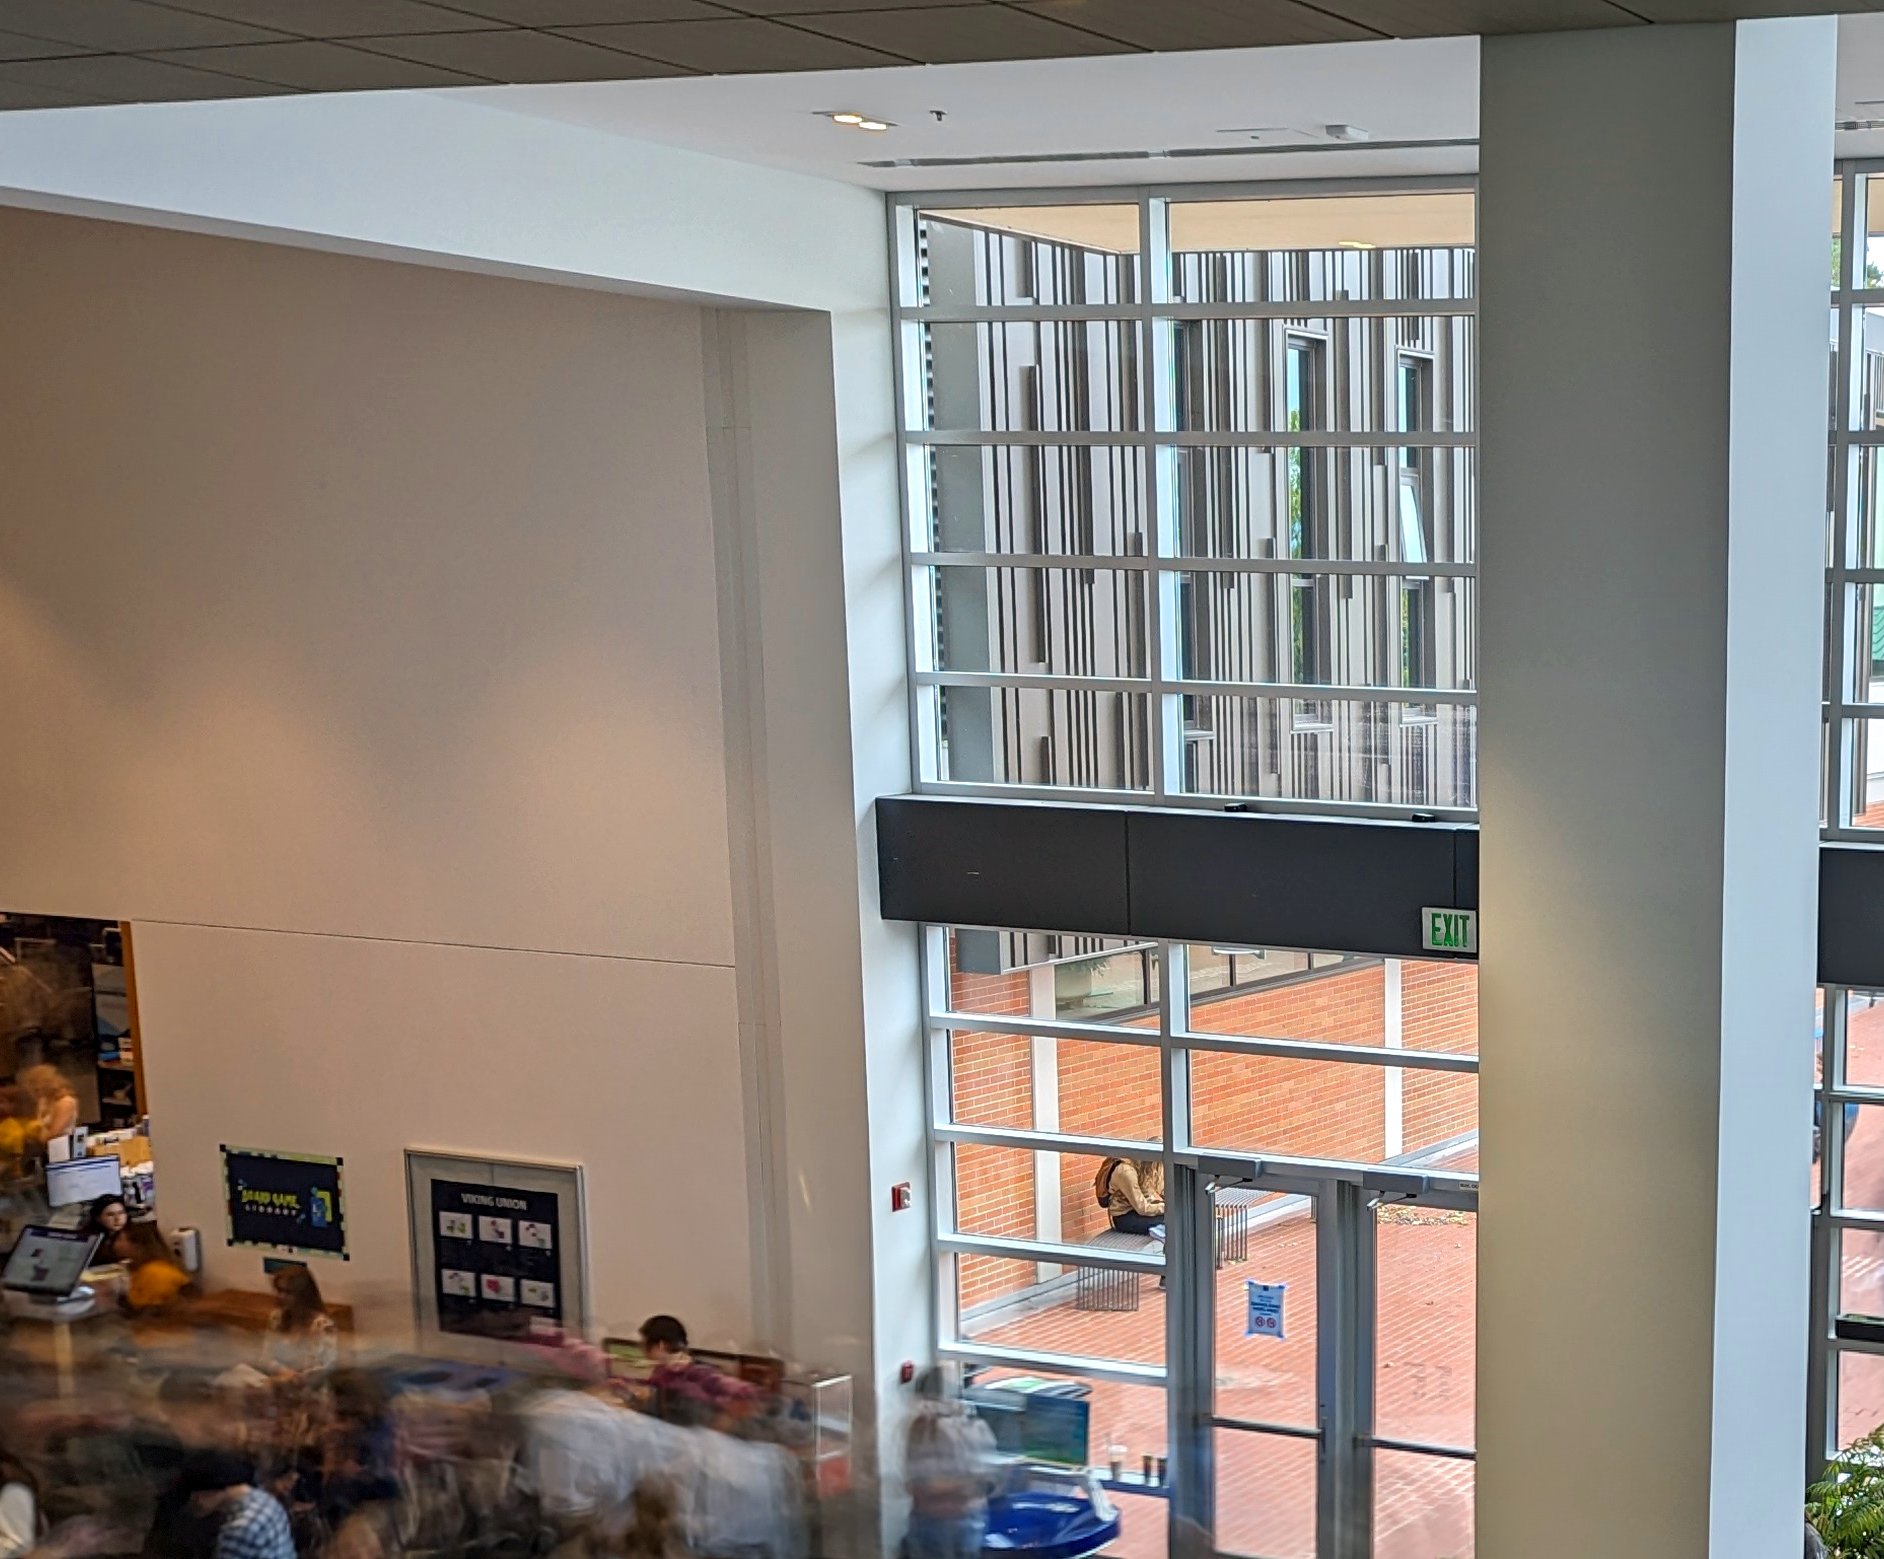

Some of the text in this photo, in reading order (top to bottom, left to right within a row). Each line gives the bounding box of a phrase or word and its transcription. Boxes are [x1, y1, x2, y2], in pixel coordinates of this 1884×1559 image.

[1431, 913, 1470, 948] EXIT
[460, 1193, 528, 1211] VIKING UNION
